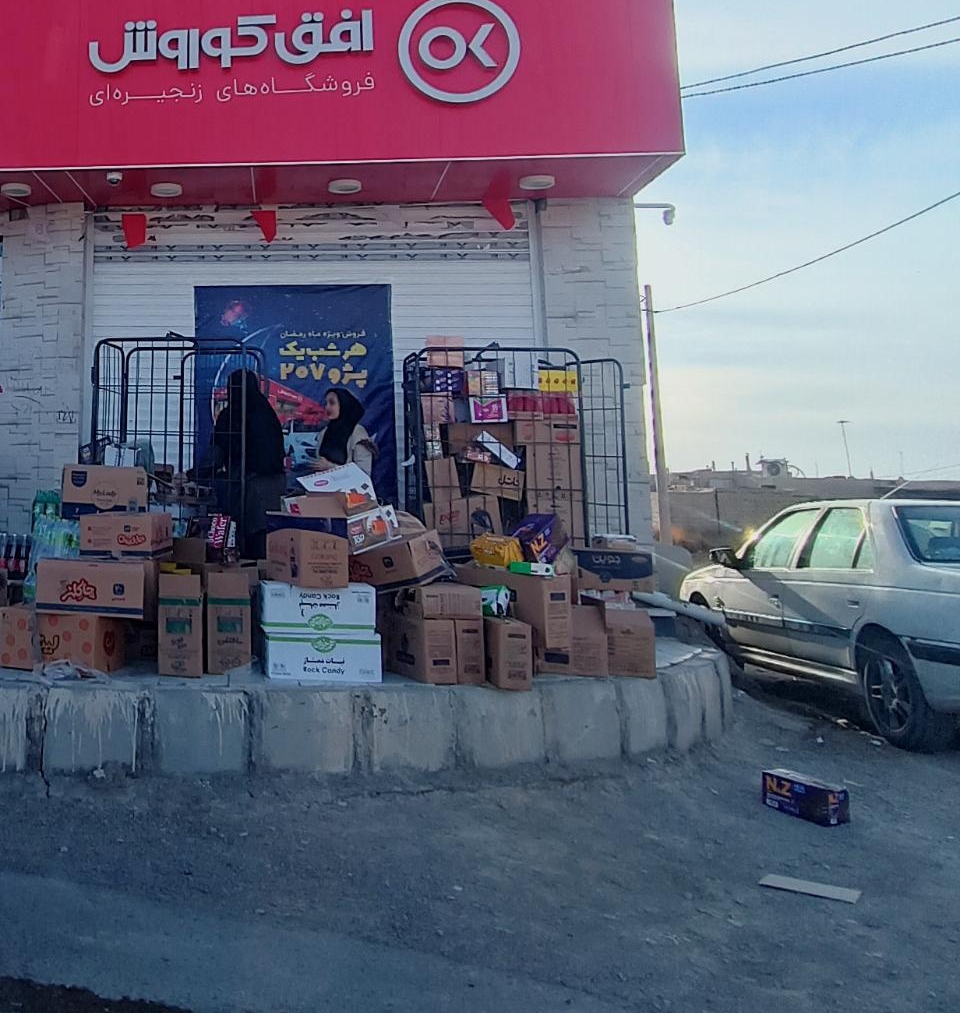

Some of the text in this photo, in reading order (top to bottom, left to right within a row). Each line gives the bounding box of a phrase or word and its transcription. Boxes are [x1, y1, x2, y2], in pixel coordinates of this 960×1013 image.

[88, 9, 375, 73] افق کوروش
[417, 23, 498, 70] OK
[278, 340, 368, 362] هر شب یک
[279, 362, 369, 389] پژو ۲۰۷
[321, 665, 345, 676] Candy
